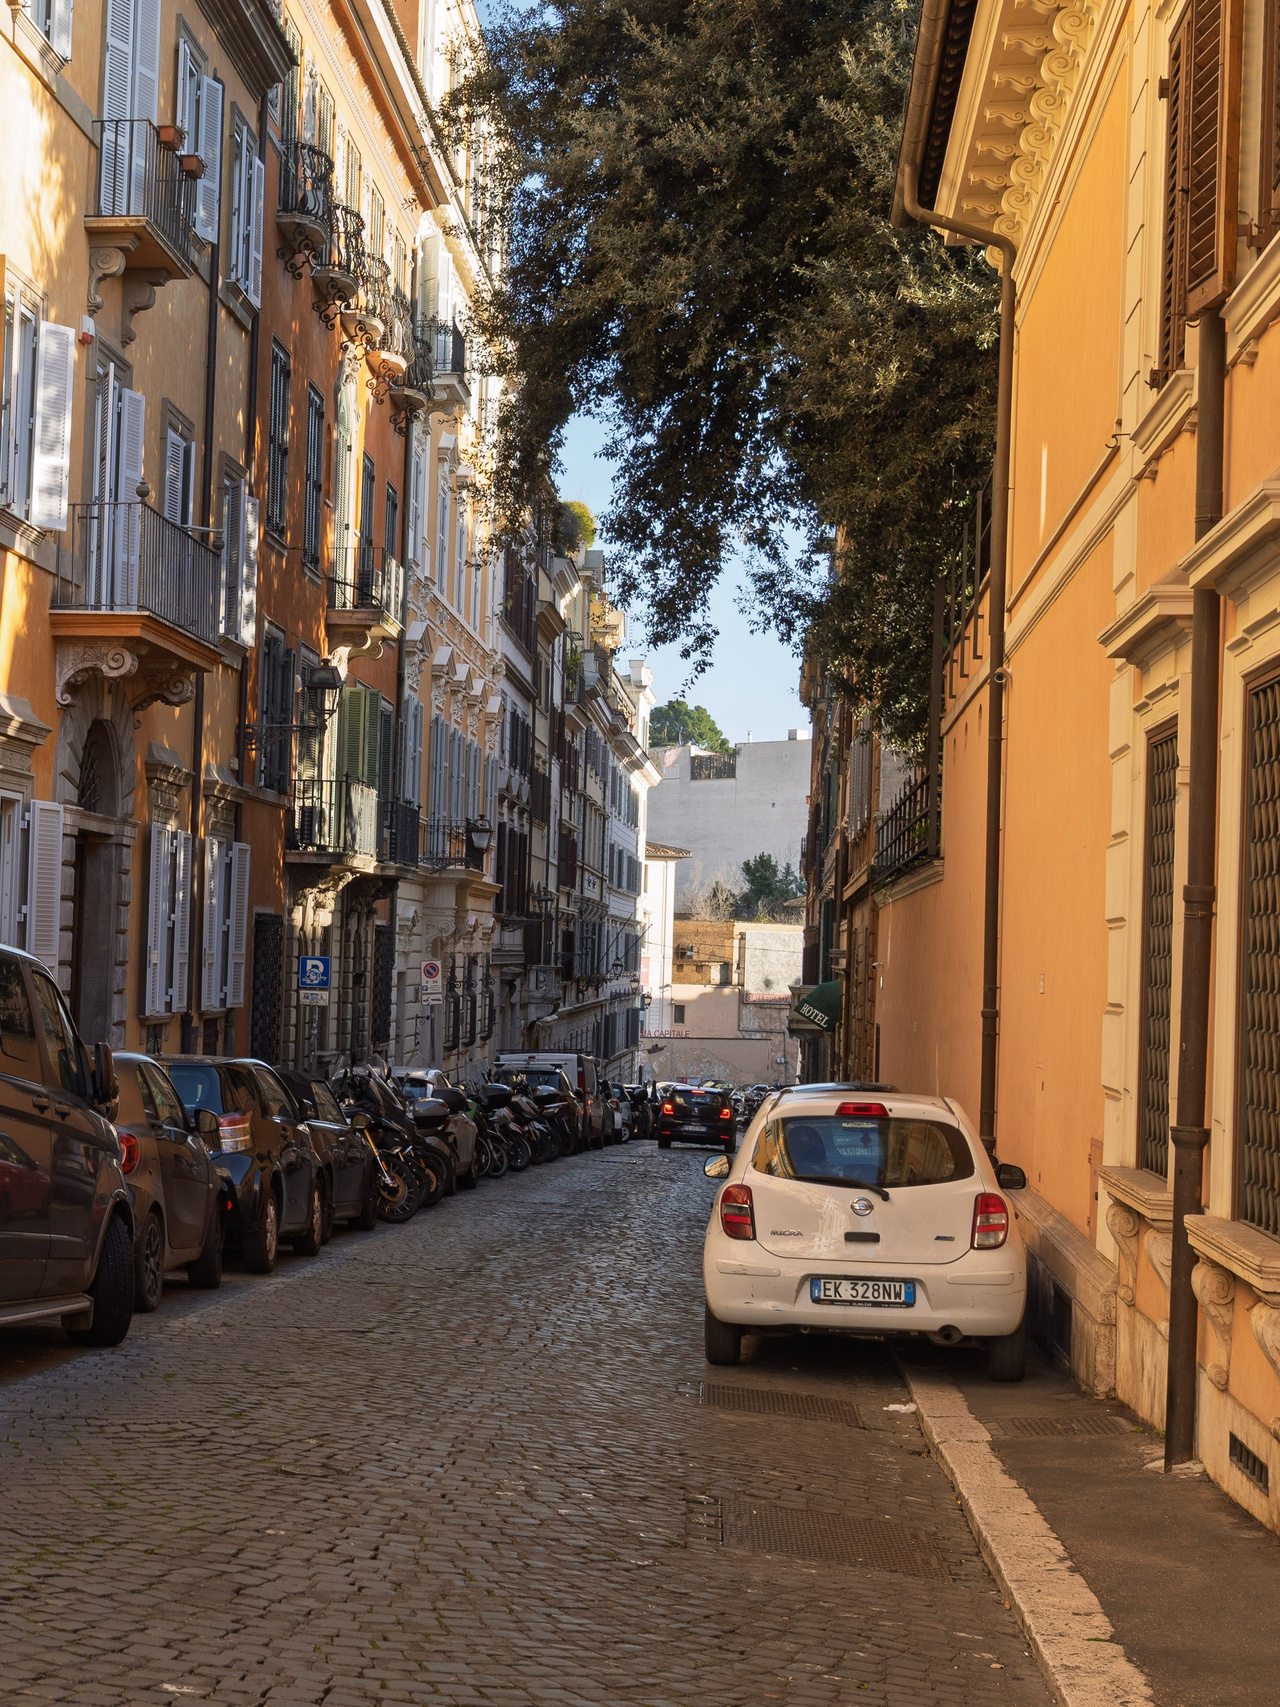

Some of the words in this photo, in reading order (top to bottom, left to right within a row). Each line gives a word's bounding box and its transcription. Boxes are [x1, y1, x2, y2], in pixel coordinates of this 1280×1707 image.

[800, 1003, 829, 1028] HOTEL
[653, 1029, 690, 1038] CAPITALE
[770, 1229, 803, 1237] MICRA
[822, 1281, 843, 1298] EK
[849, 1282, 902, 1301] 328NW
